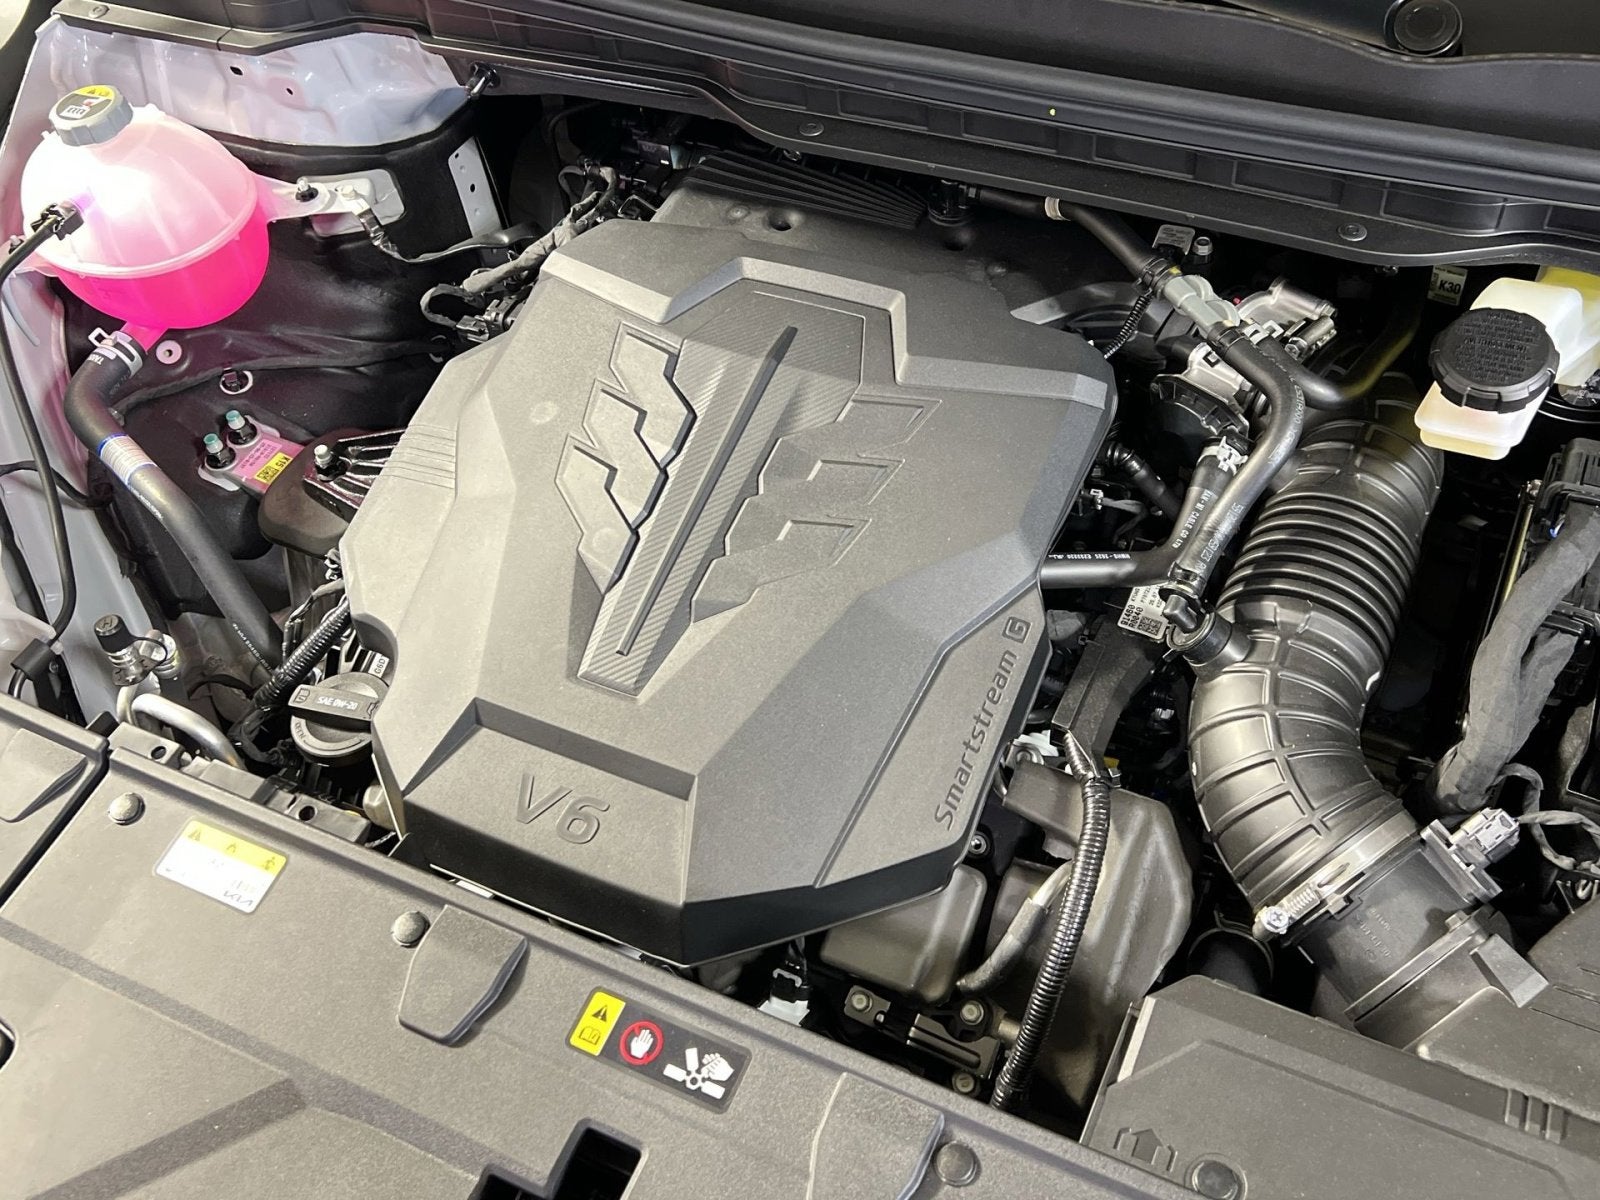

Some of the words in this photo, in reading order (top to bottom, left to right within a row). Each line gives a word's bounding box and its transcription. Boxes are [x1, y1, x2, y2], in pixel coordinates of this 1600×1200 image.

[1439, 279, 1461, 295] K30
[316, 695, 334, 706] SAE
[332, 698, 359, 711] 0W-20
[934, 649, 1018, 831] Smartstream
[1002, 616, 1032, 644] G
[516, 772, 611, 845] V6
[223, 890, 254, 907] KIA
